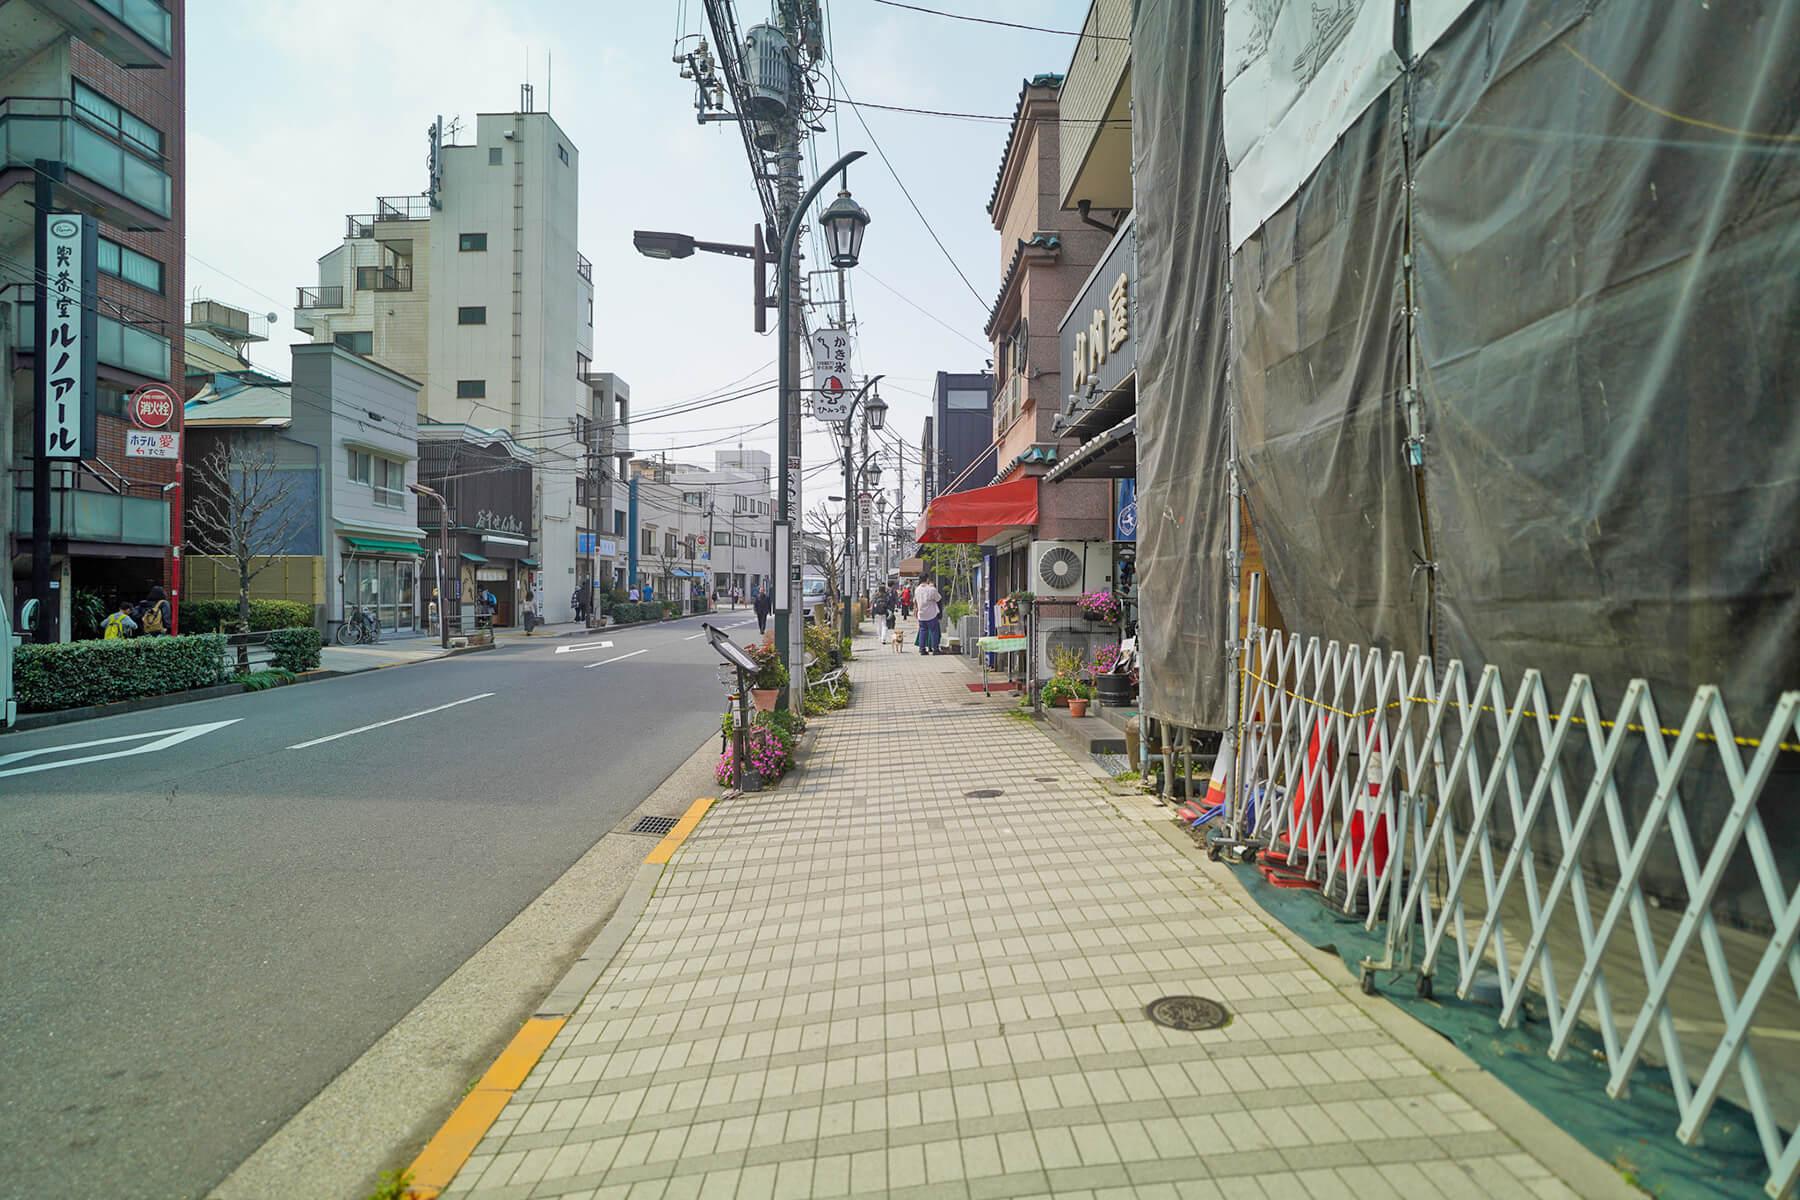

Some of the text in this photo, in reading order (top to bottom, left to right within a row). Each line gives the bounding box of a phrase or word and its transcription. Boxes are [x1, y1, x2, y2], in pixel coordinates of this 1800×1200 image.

[49, 246, 78, 452] 喫茶室ルノアール
[834, 336, 846, 373] かき氷
[140, 401, 170, 416] 消火栓
[817, 405, 848, 414] ひみつ堂
[130, 434, 174, 449] ホテル 愛
